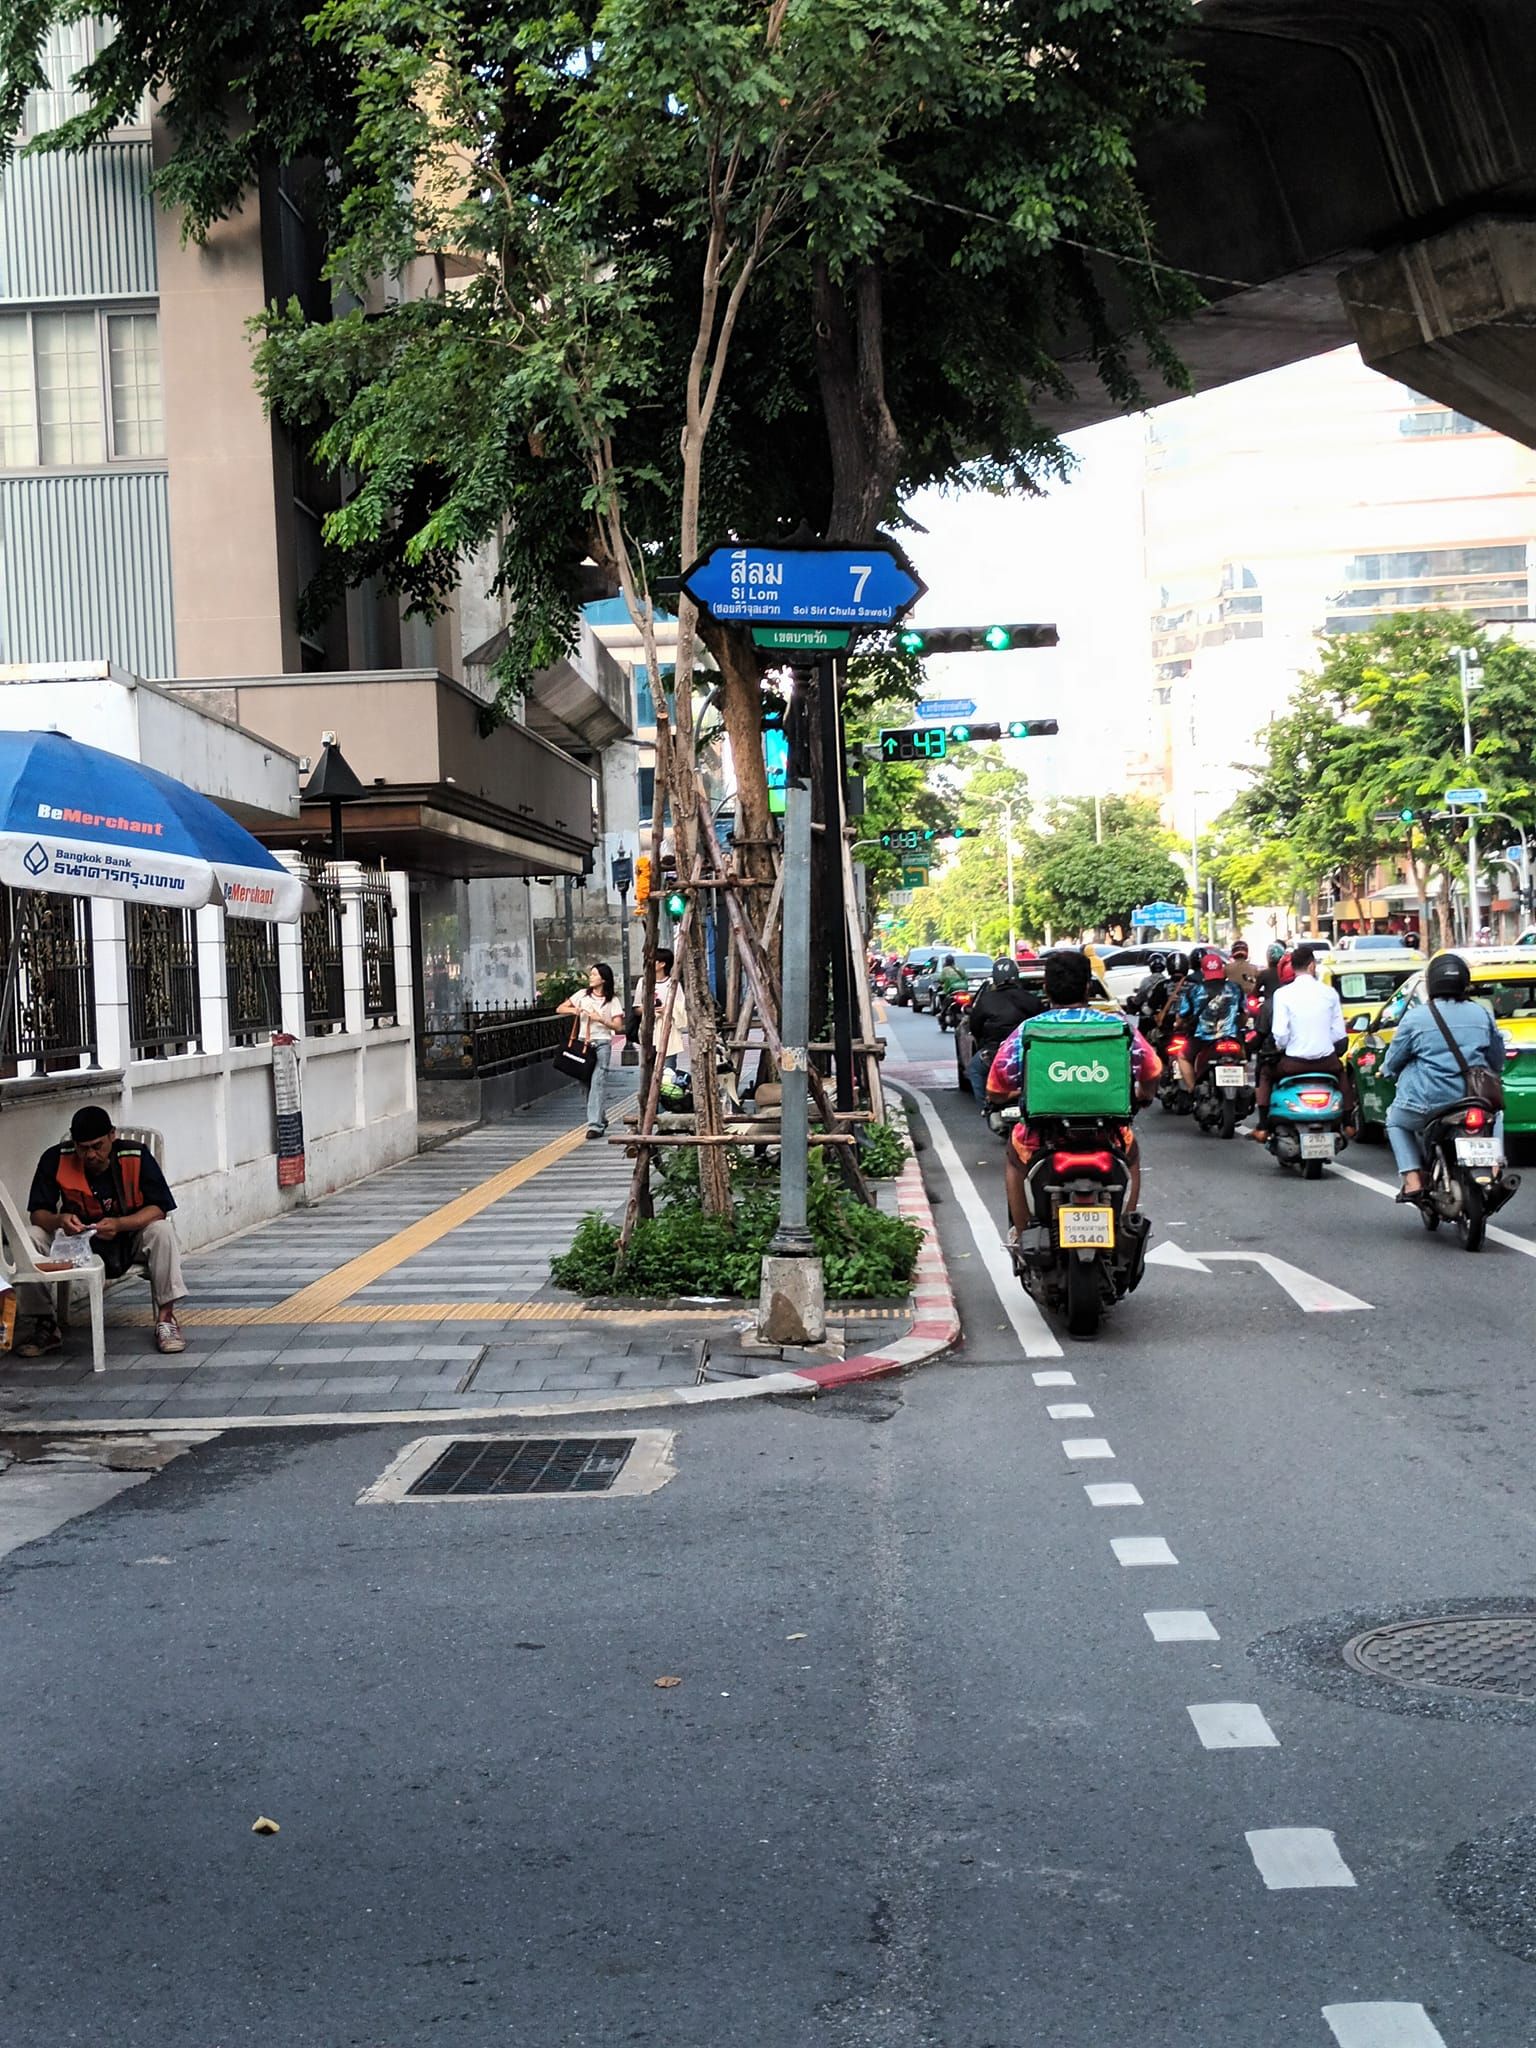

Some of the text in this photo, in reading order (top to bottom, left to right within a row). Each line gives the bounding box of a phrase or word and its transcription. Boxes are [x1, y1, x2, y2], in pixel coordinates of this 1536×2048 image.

[731, 549, 872, 603] สีลม 7
[731, 587, 778, 600] Si Lom
[793, 606, 808, 615] Soi
[810, 606, 827, 615] Siri
[829, 606, 856, 616] Chula
[913, 729, 945, 758] 43
[37, 803, 165, 836] BeMerchant
[55, 849, 132, 868] Bangkok Bank
[53, 862, 185, 889] ธนาคารกรุงเทพ
[1048, 1060, 1109, 1082] Grab
